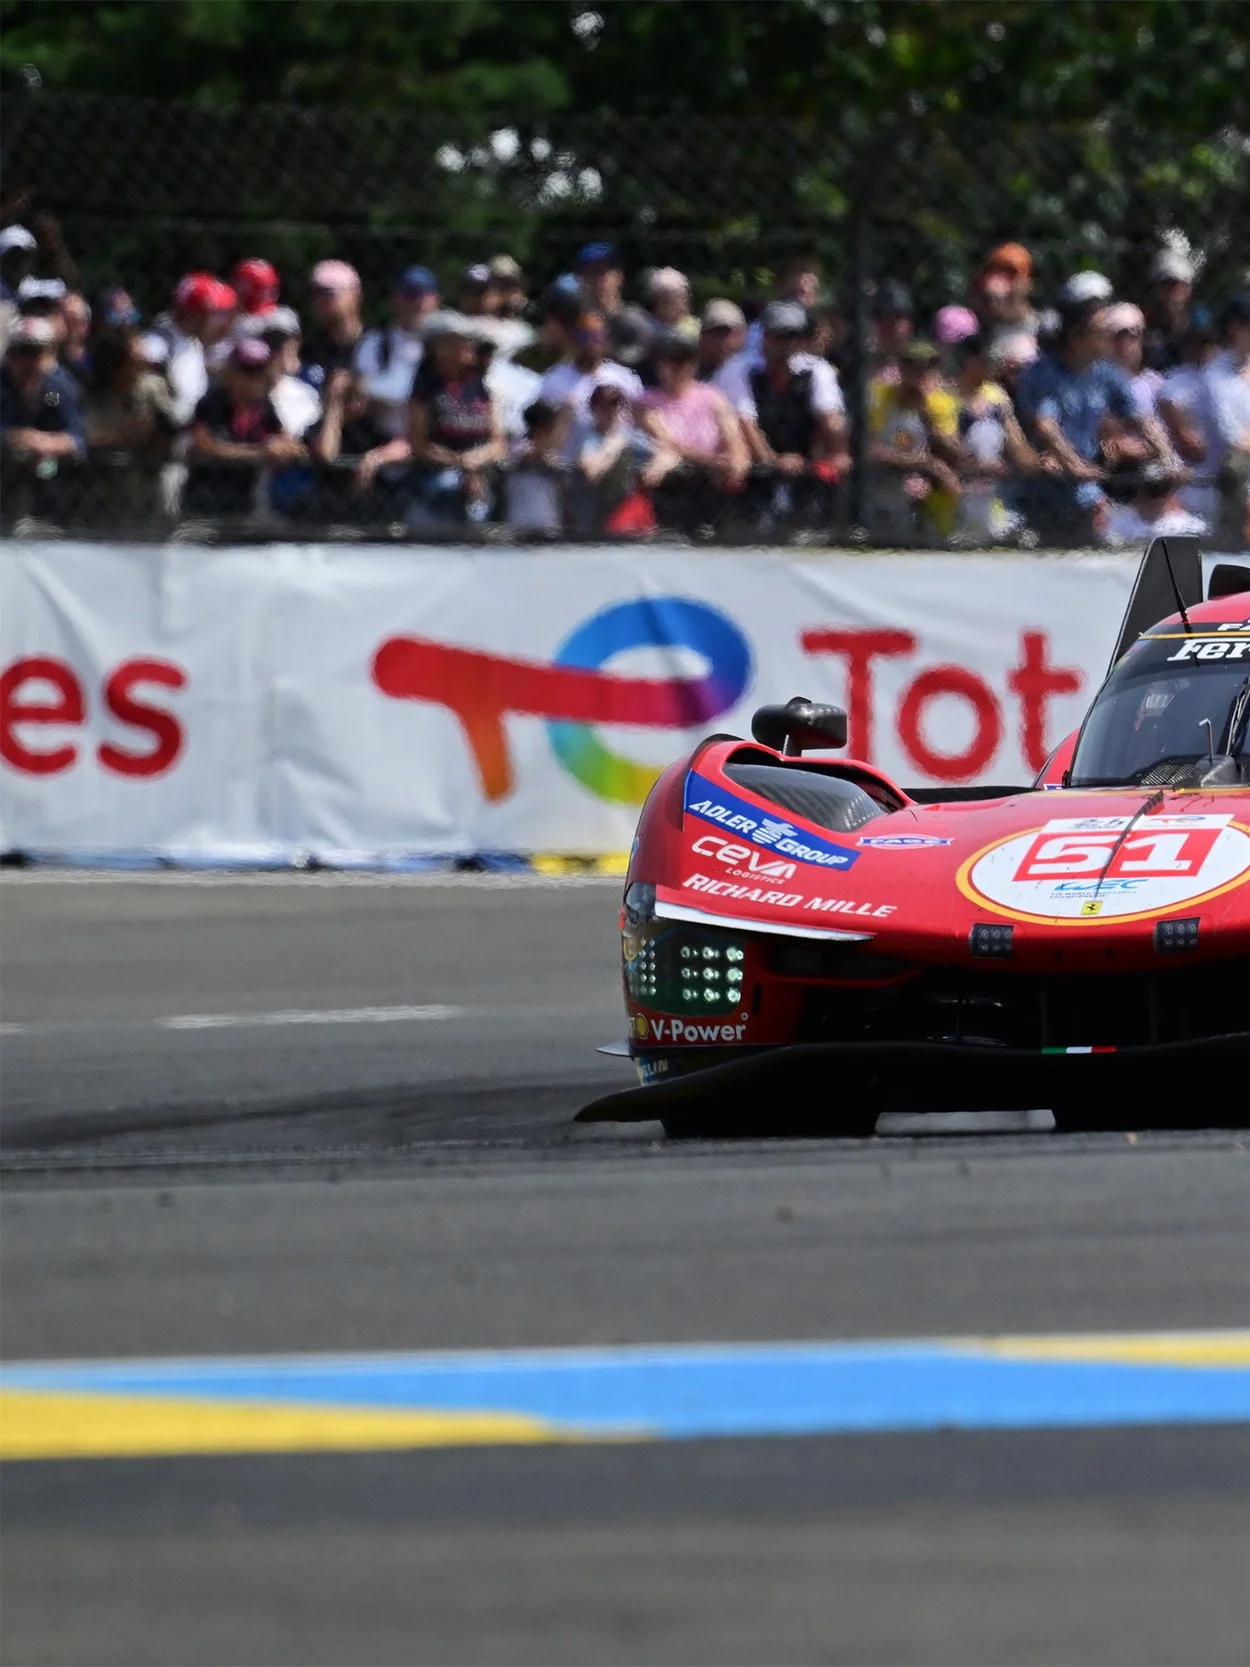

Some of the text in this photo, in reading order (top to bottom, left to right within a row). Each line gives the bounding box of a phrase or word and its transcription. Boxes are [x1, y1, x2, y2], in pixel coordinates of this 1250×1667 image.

[0, 654, 188, 777] es
[689, 800, 848, 865] ADLER GROUP
[691, 836, 797, 879] CEVA
[725, 867, 785, 884] LOGISTICS
[1027, 833, 1193, 876] 51
[682, 873, 897, 917] RICHARD MILLE
[651, 1019, 746, 1041] V-Power
